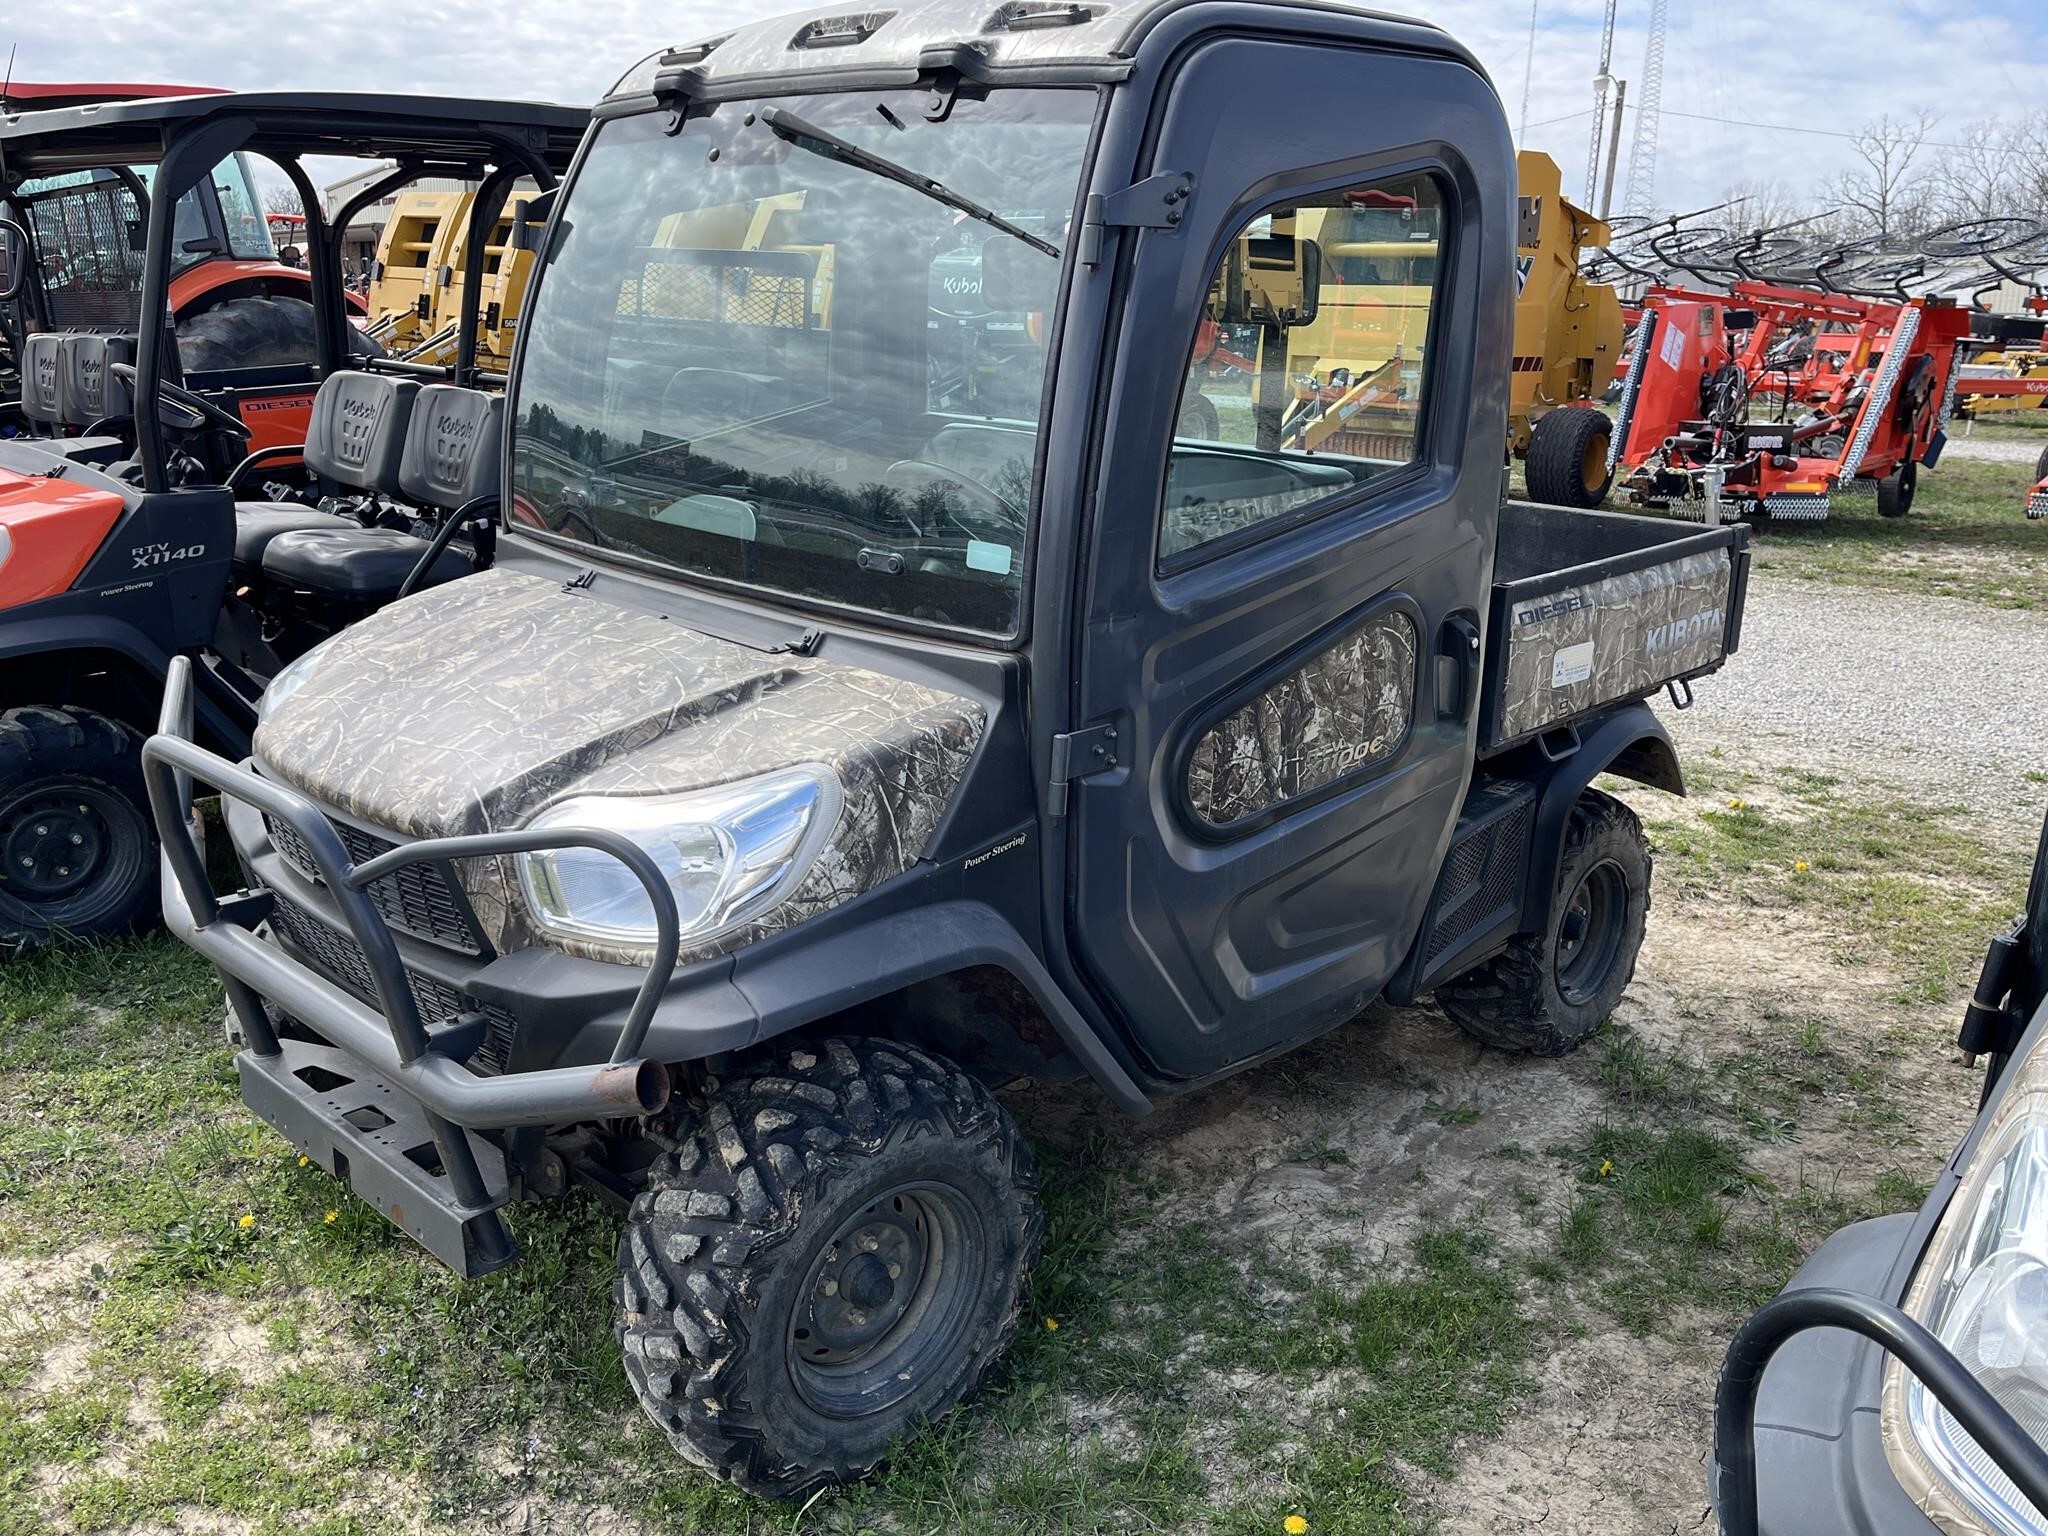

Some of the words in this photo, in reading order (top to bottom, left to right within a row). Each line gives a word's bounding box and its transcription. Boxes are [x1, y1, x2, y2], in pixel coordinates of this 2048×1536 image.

[131, 542, 169, 556] RTV
[132, 544, 205, 569] X1140
[101, 587, 124, 597] Power
[124, 581, 154, 592] Steering
[1518, 596, 1594, 627] DIESEL
[1646, 607, 1721, 658] KUBOTA
[964, 851, 991, 870] Power
[991, 832, 1027, 857] Steering
